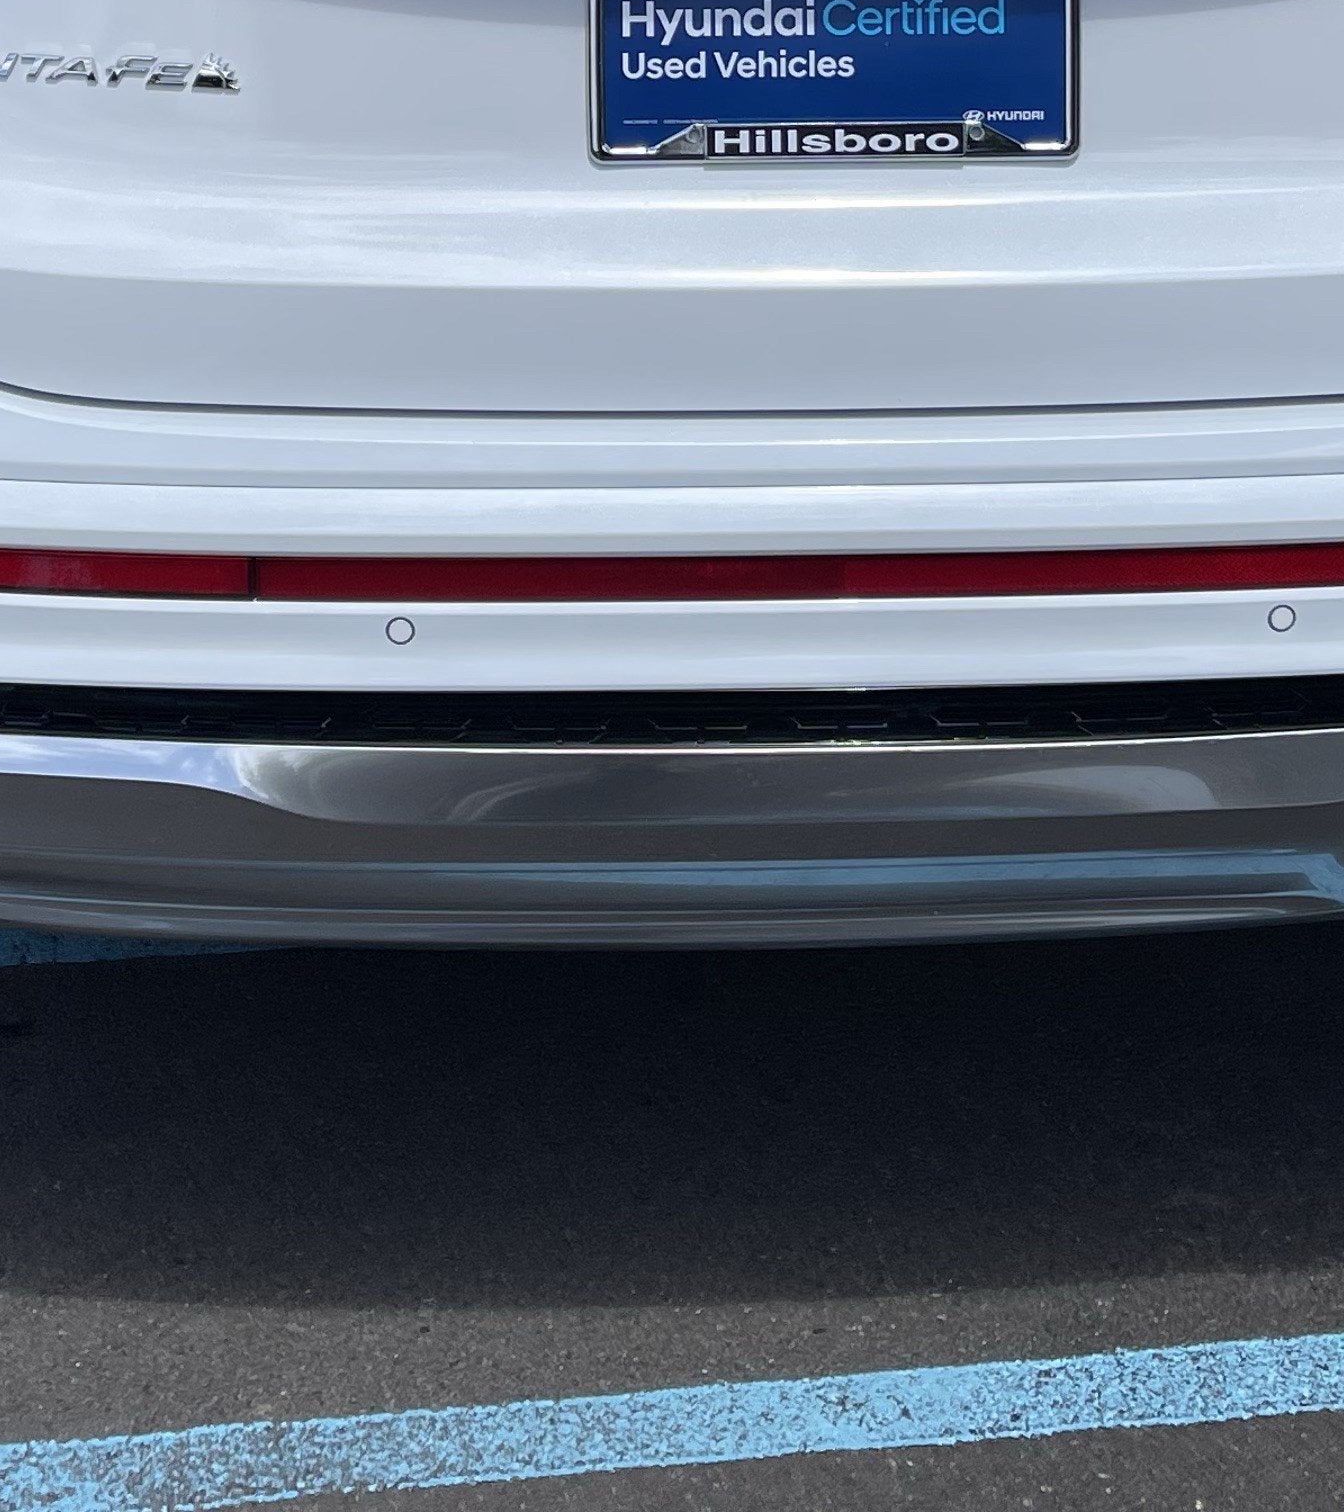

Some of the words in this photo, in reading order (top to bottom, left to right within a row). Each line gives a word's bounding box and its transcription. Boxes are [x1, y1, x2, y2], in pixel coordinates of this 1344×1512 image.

[622, 52, 706, 79] Used
[713, 50, 855, 78] Vehicles
[987, 110, 1045, 121] HYUNDAI
[714, 129, 958, 154] Hillsboro
